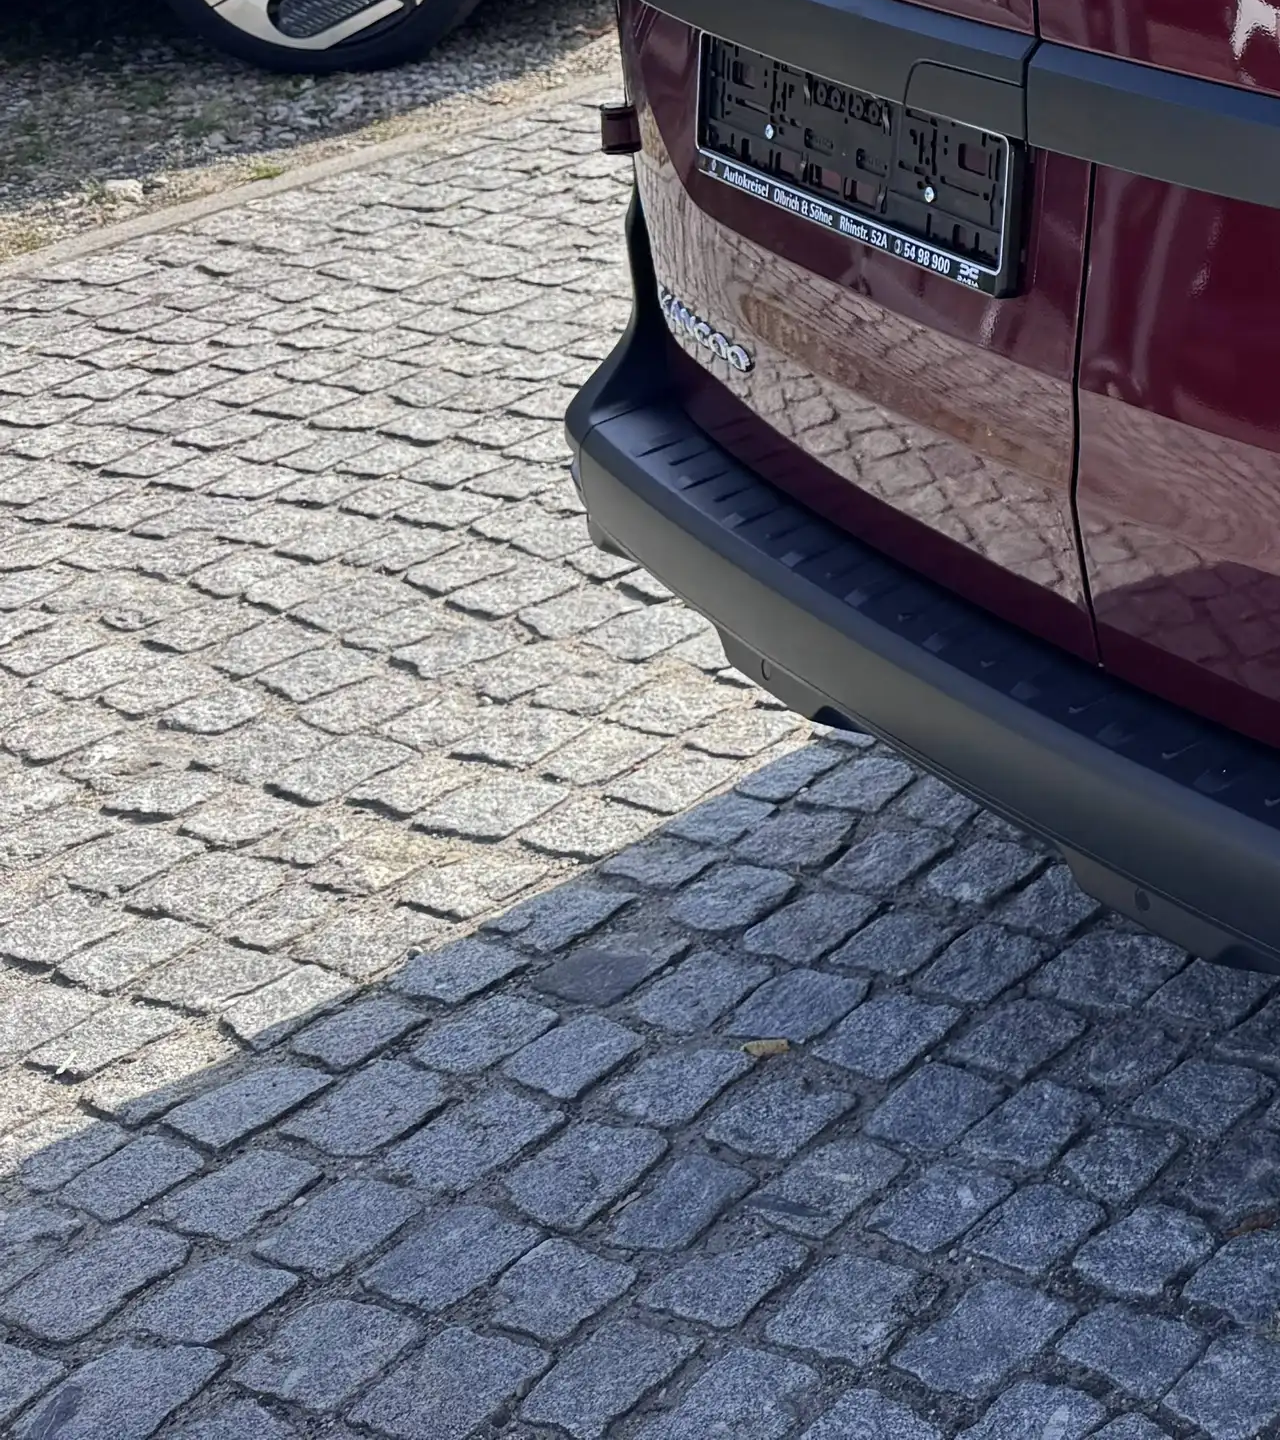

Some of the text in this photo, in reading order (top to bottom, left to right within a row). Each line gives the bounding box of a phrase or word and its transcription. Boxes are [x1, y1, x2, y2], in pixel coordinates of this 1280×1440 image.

[723, 165, 951, 274] Autokreisel Olbrich & Söhne Rhinstr. 52A 54 98 900
